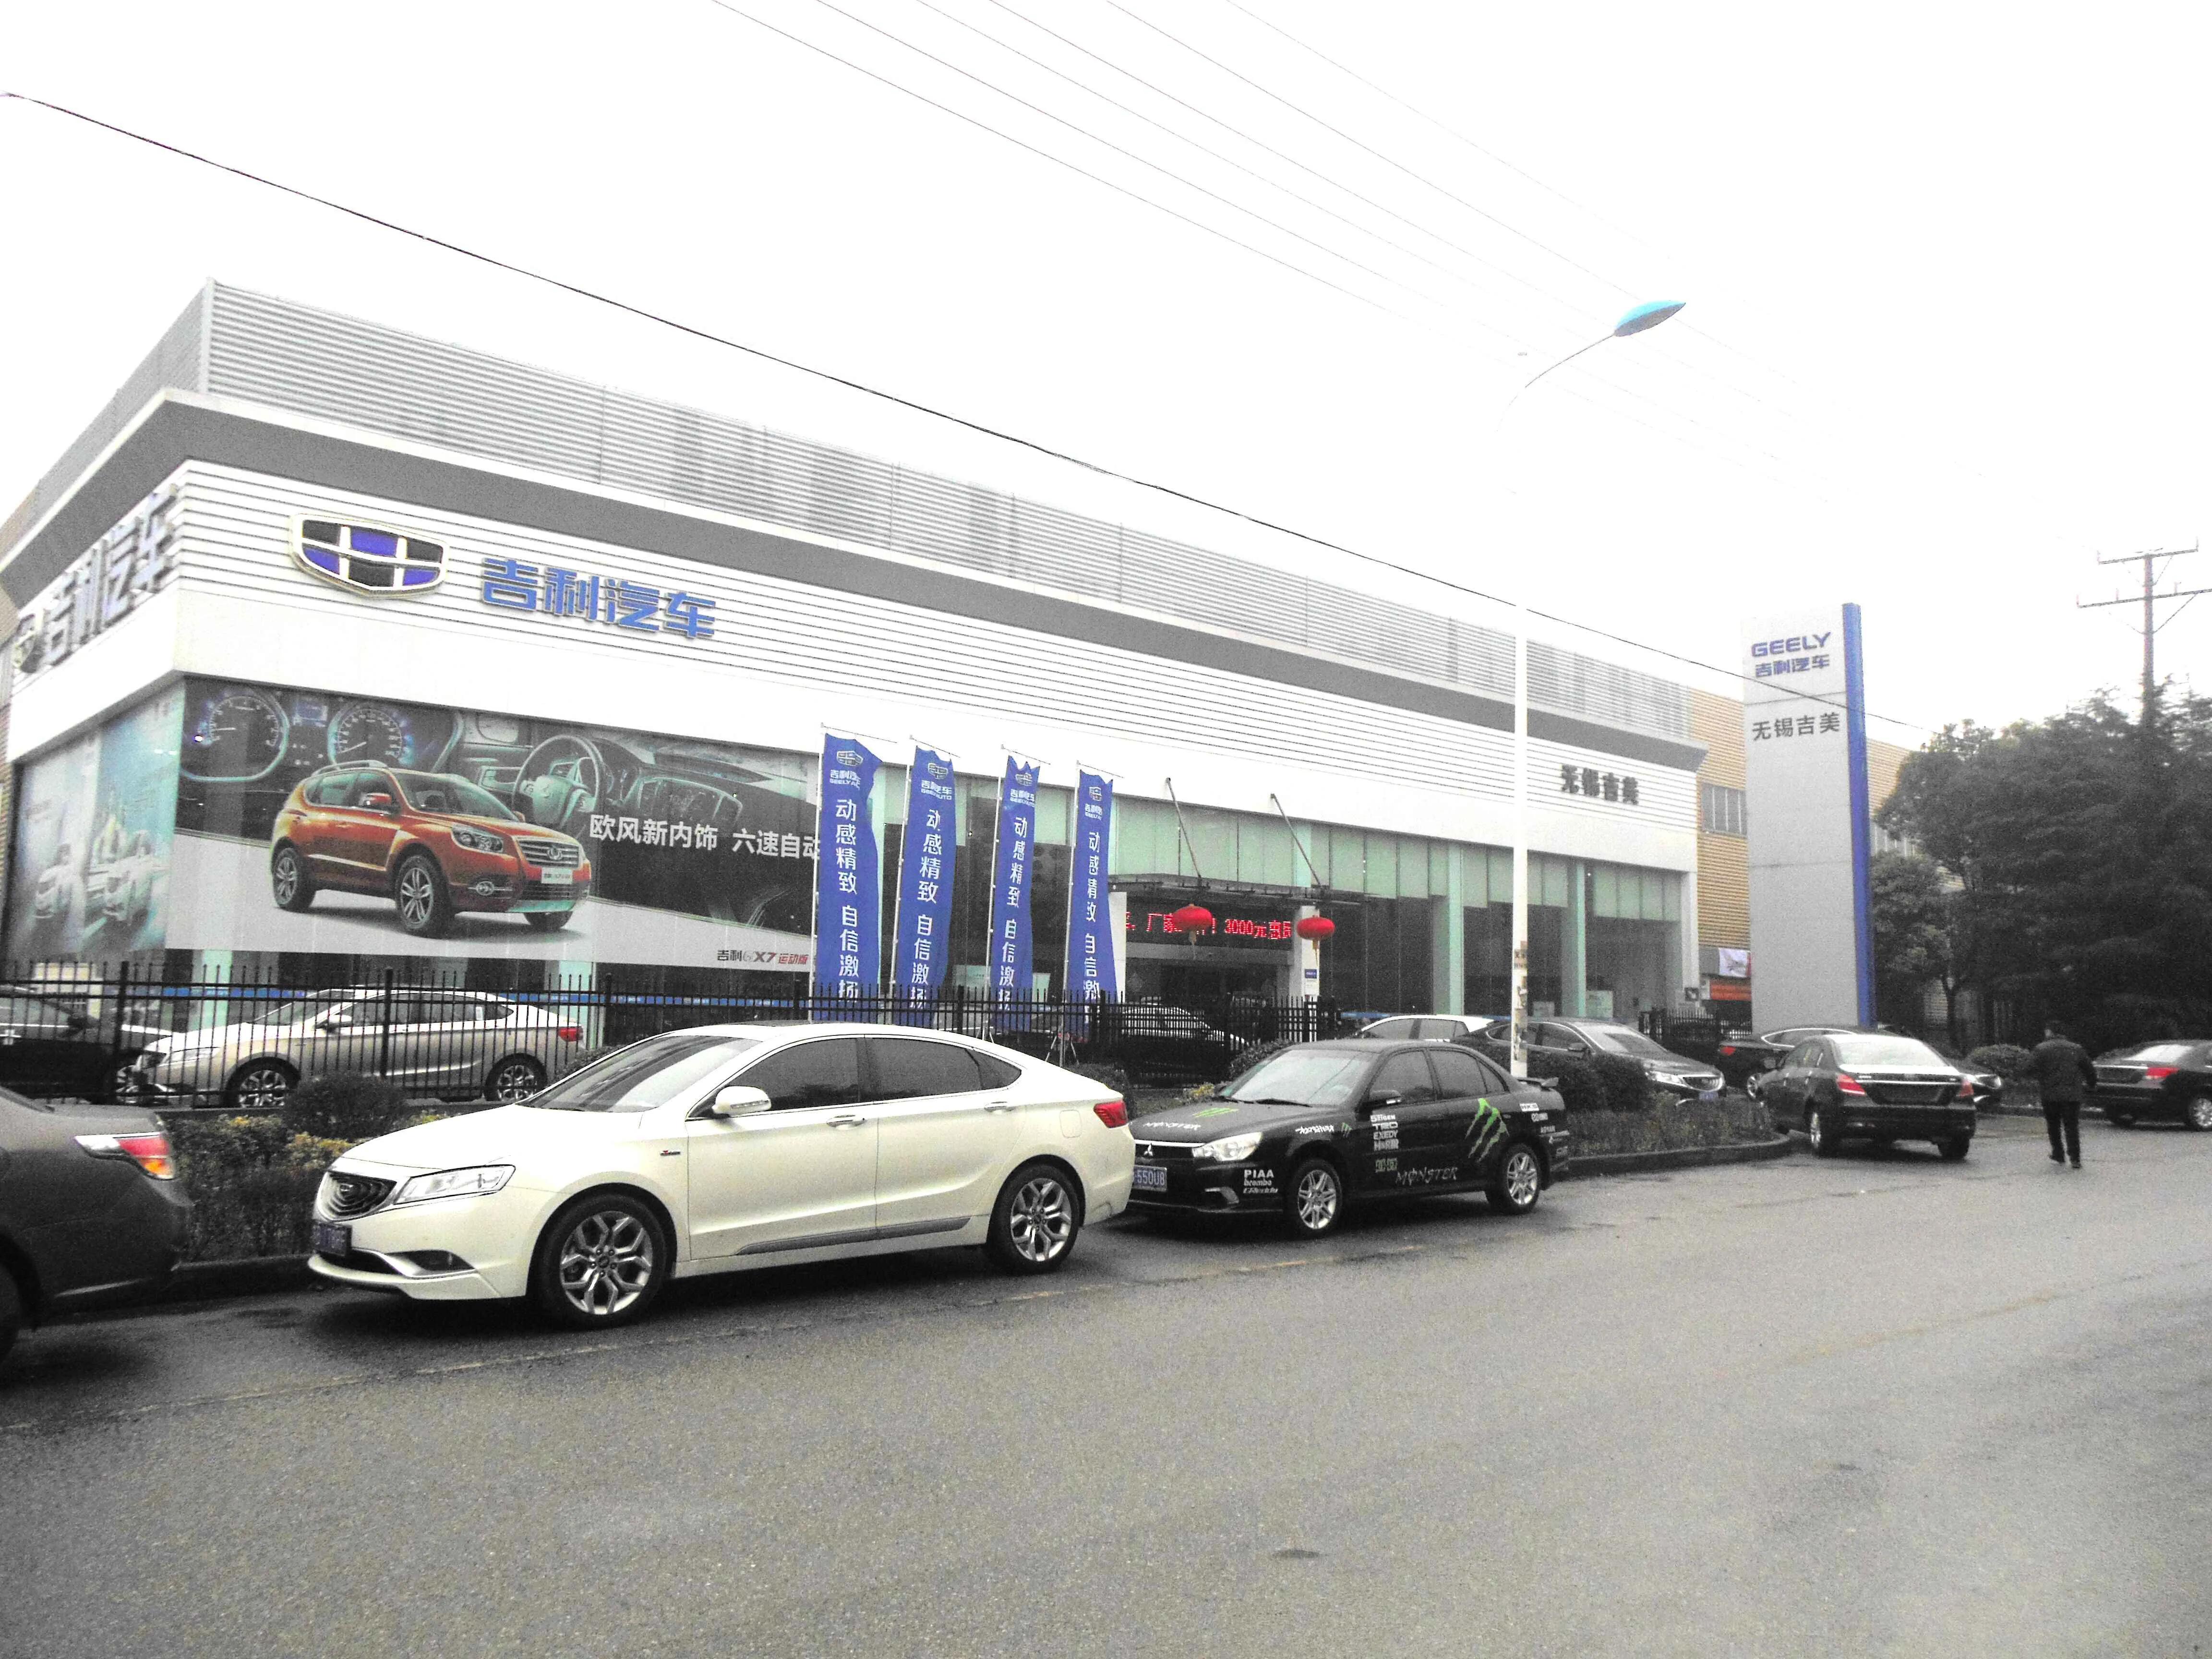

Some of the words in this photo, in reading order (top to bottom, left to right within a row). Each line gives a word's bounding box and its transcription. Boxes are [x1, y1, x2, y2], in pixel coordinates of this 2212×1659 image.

[481, 557, 716, 638] 吉利汽车
[1751, 632, 1831, 657] GEELY
[1755, 654, 1830, 678] 吉利汽车
[1752, 712, 1840, 741] 无锡吉美
[590, 814, 719, 851] 欧风新内饰
[835, 799, 857, 895] 动感精致
[917, 808, 942, 904] 动感精致
[1243, 1178, 1273, 1186] brembo
[1244, 1169, 1274, 1178] PIAA
